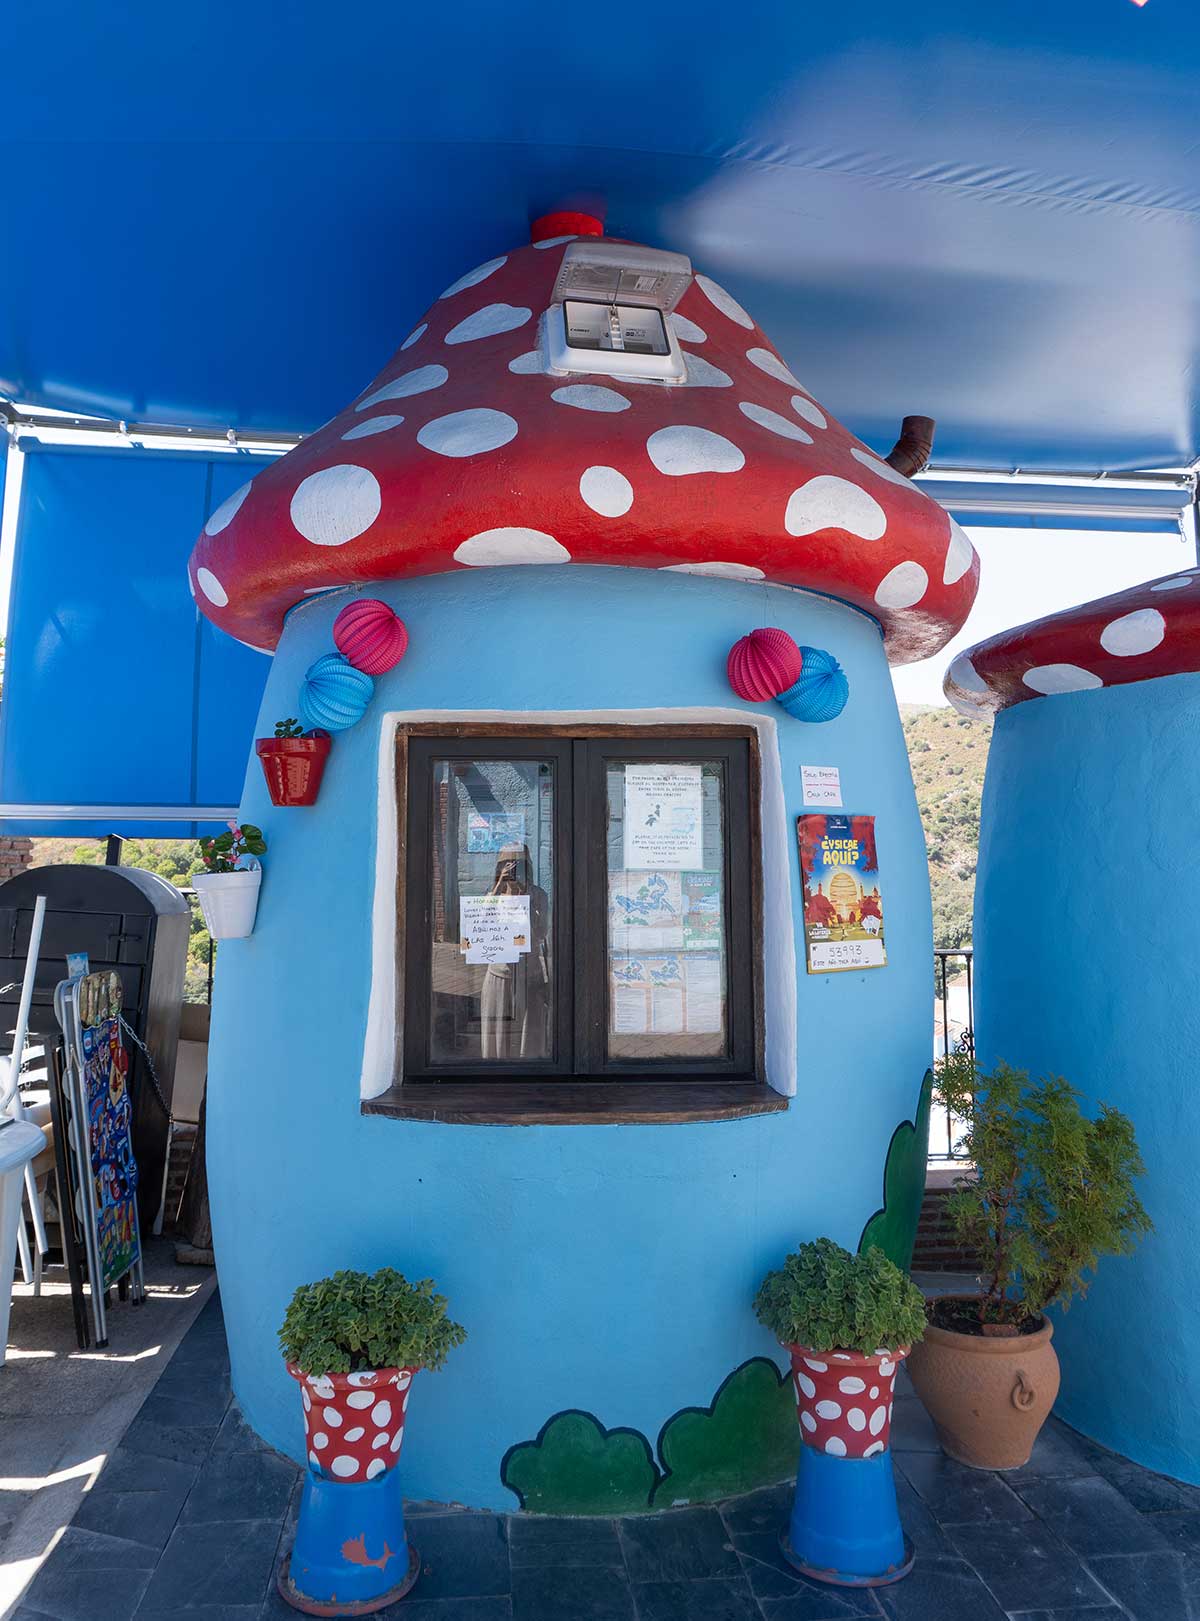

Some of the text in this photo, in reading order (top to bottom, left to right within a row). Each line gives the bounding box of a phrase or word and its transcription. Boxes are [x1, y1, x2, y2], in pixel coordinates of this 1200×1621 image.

[835, 839, 843, 849] SI
[843, 839, 859, 850] CAE
[822, 849, 859, 866] AQUÍ?
